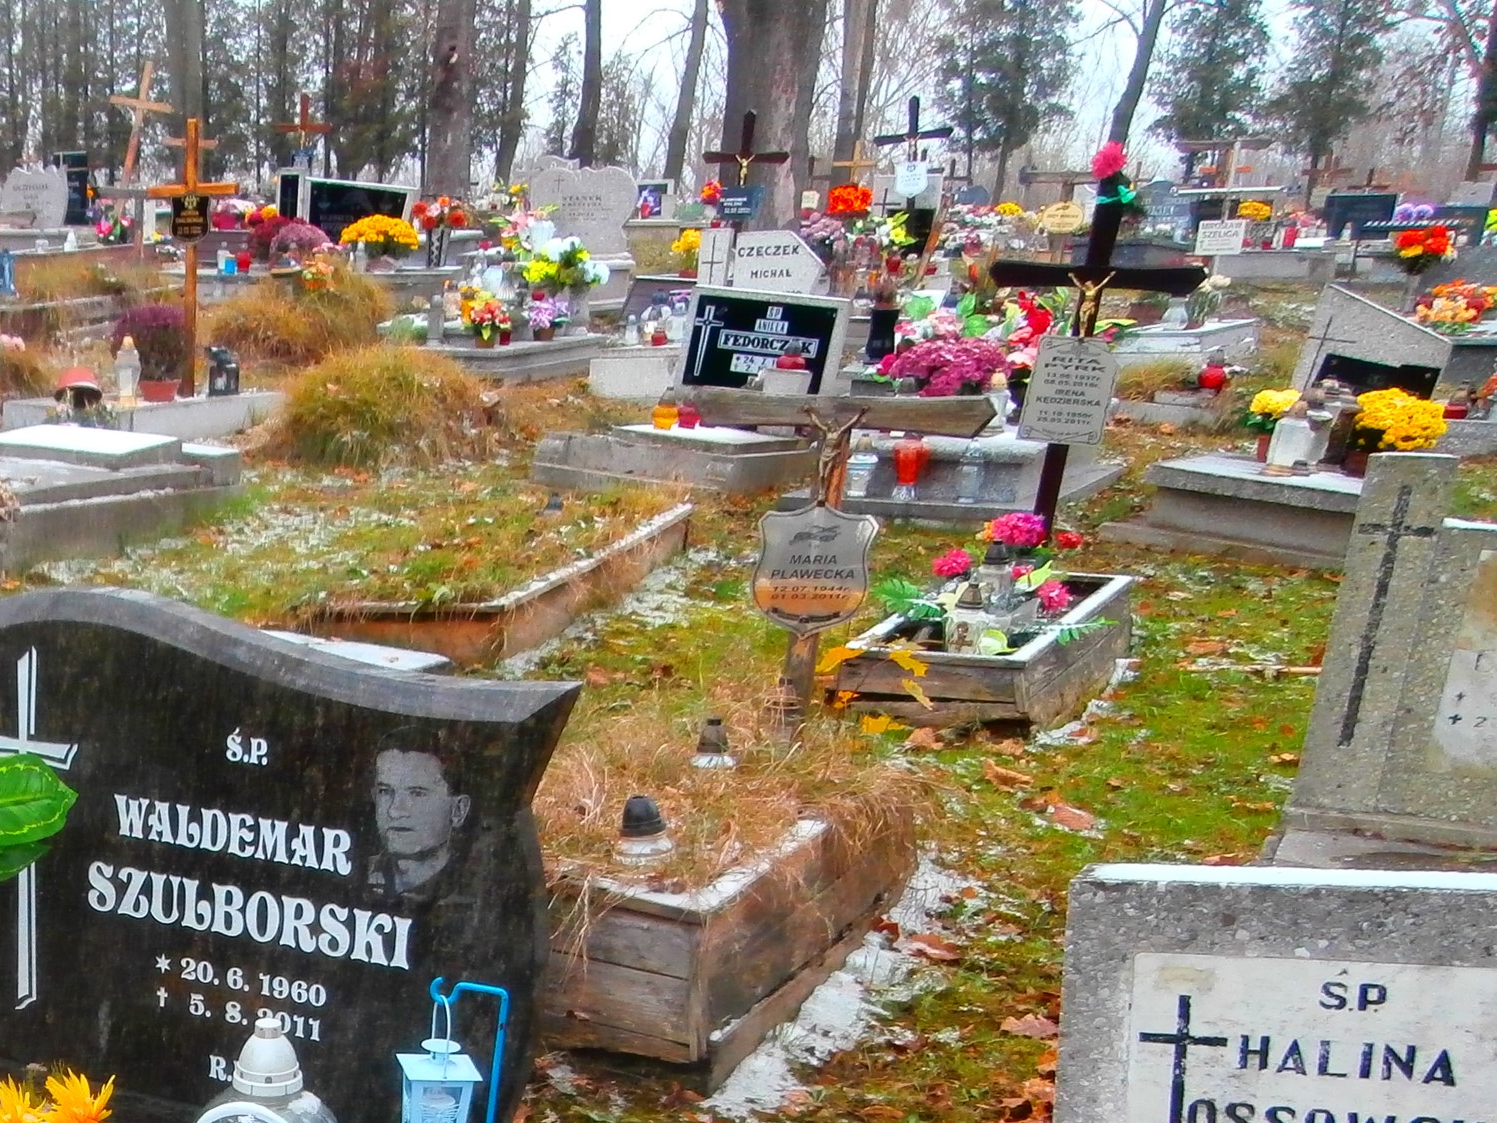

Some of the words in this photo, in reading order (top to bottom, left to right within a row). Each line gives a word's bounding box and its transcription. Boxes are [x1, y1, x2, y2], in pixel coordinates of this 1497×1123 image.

[738, 245, 800, 258] CZECZEK
[750, 269, 792, 279] MICHAŁ
[756, 320, 786, 332] ANIELA
[723, 334, 814, 355] FEDORCZK
[1052, 356, 1101, 365] RITA
[1044, 363, 1106, 373] PYRK
[1055, 389, 1085, 397] IRENA
[789, 554, 837, 565] MARIA
[114, 793, 352, 876] WALDEMAR
[87, 860, 413, 970] SZULBORSKI
[259, 972, 327, 1007] 1960
[1237, 1034, 1457, 1088] HALINA
